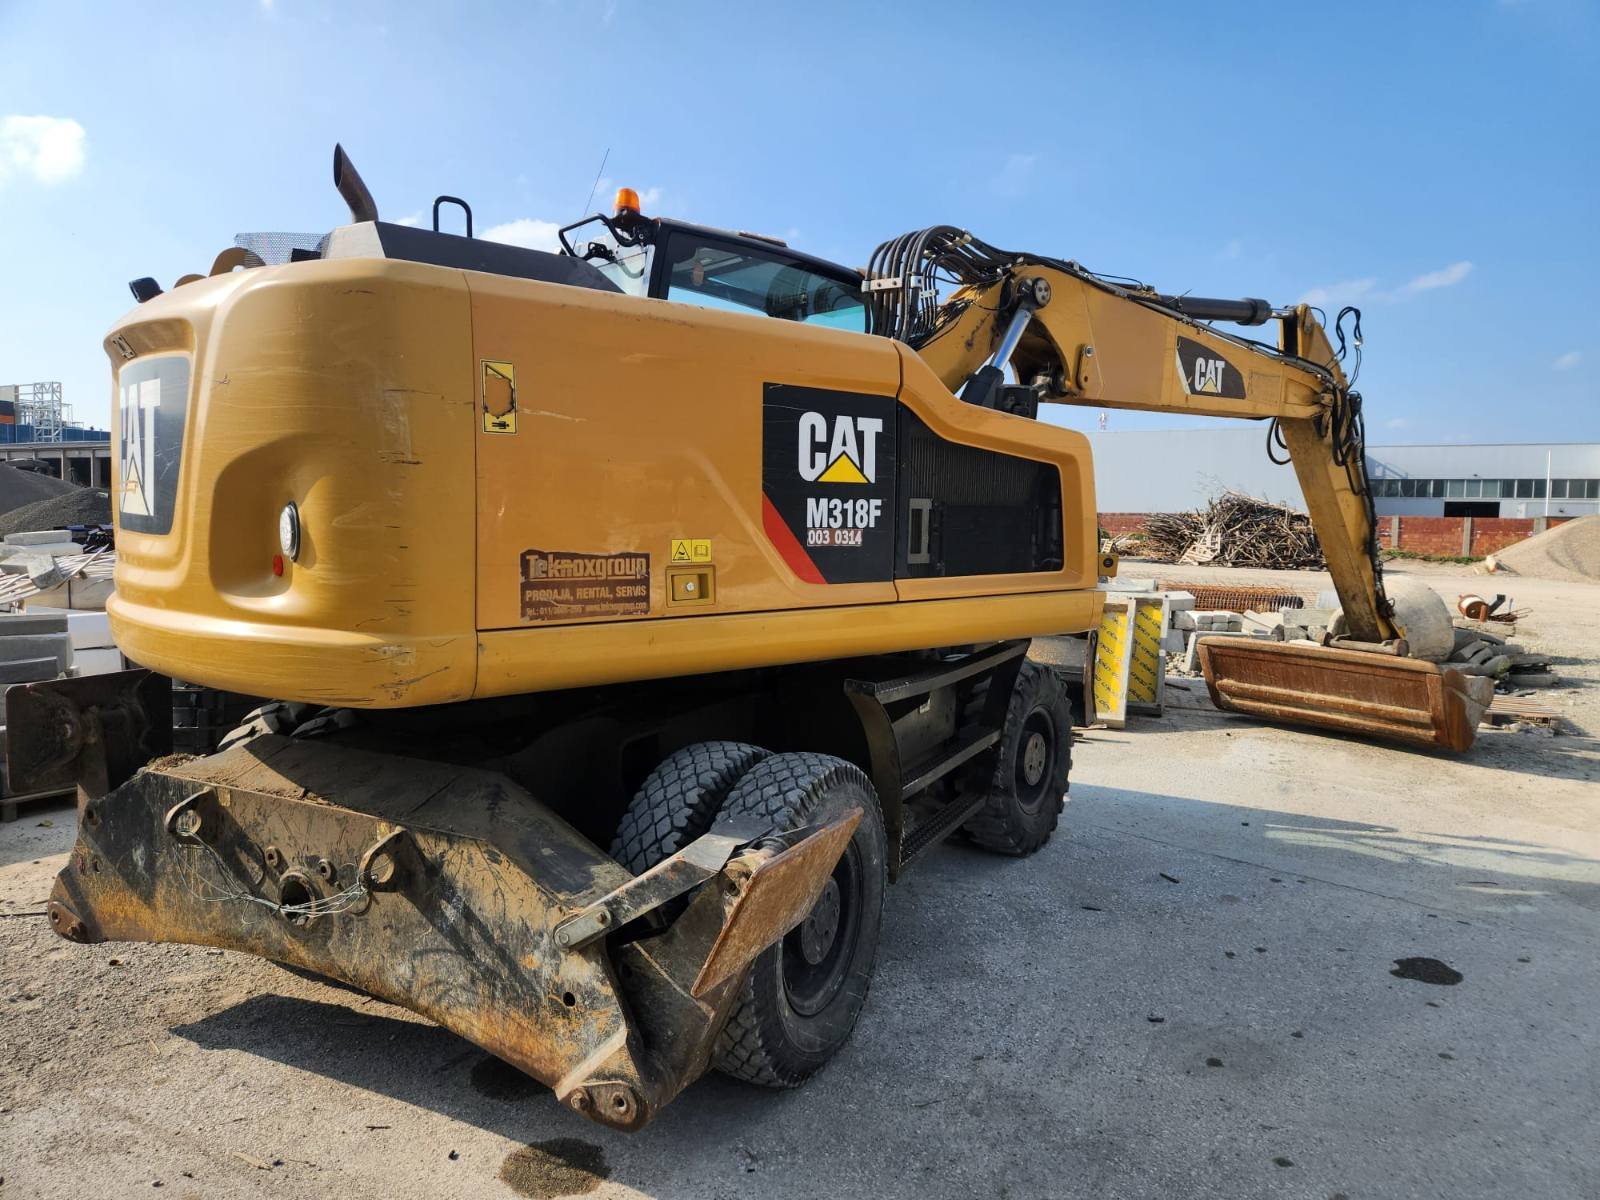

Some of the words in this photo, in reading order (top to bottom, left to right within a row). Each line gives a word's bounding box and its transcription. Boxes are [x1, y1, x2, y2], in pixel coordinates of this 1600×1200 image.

[1195, 357, 1225, 393] CAT
[798, 411, 883, 484] CAT
[807, 498, 882, 529] M318F
[808, 530, 830, 544] 003
[834, 530, 862, 545] 0314
[526, 554, 647, 580] Teknoxgroup
[526, 589, 573, 602] PRODAJA,
[576, 587, 613, 600] RENTAL,
[616, 586, 646, 597] SERVIS
